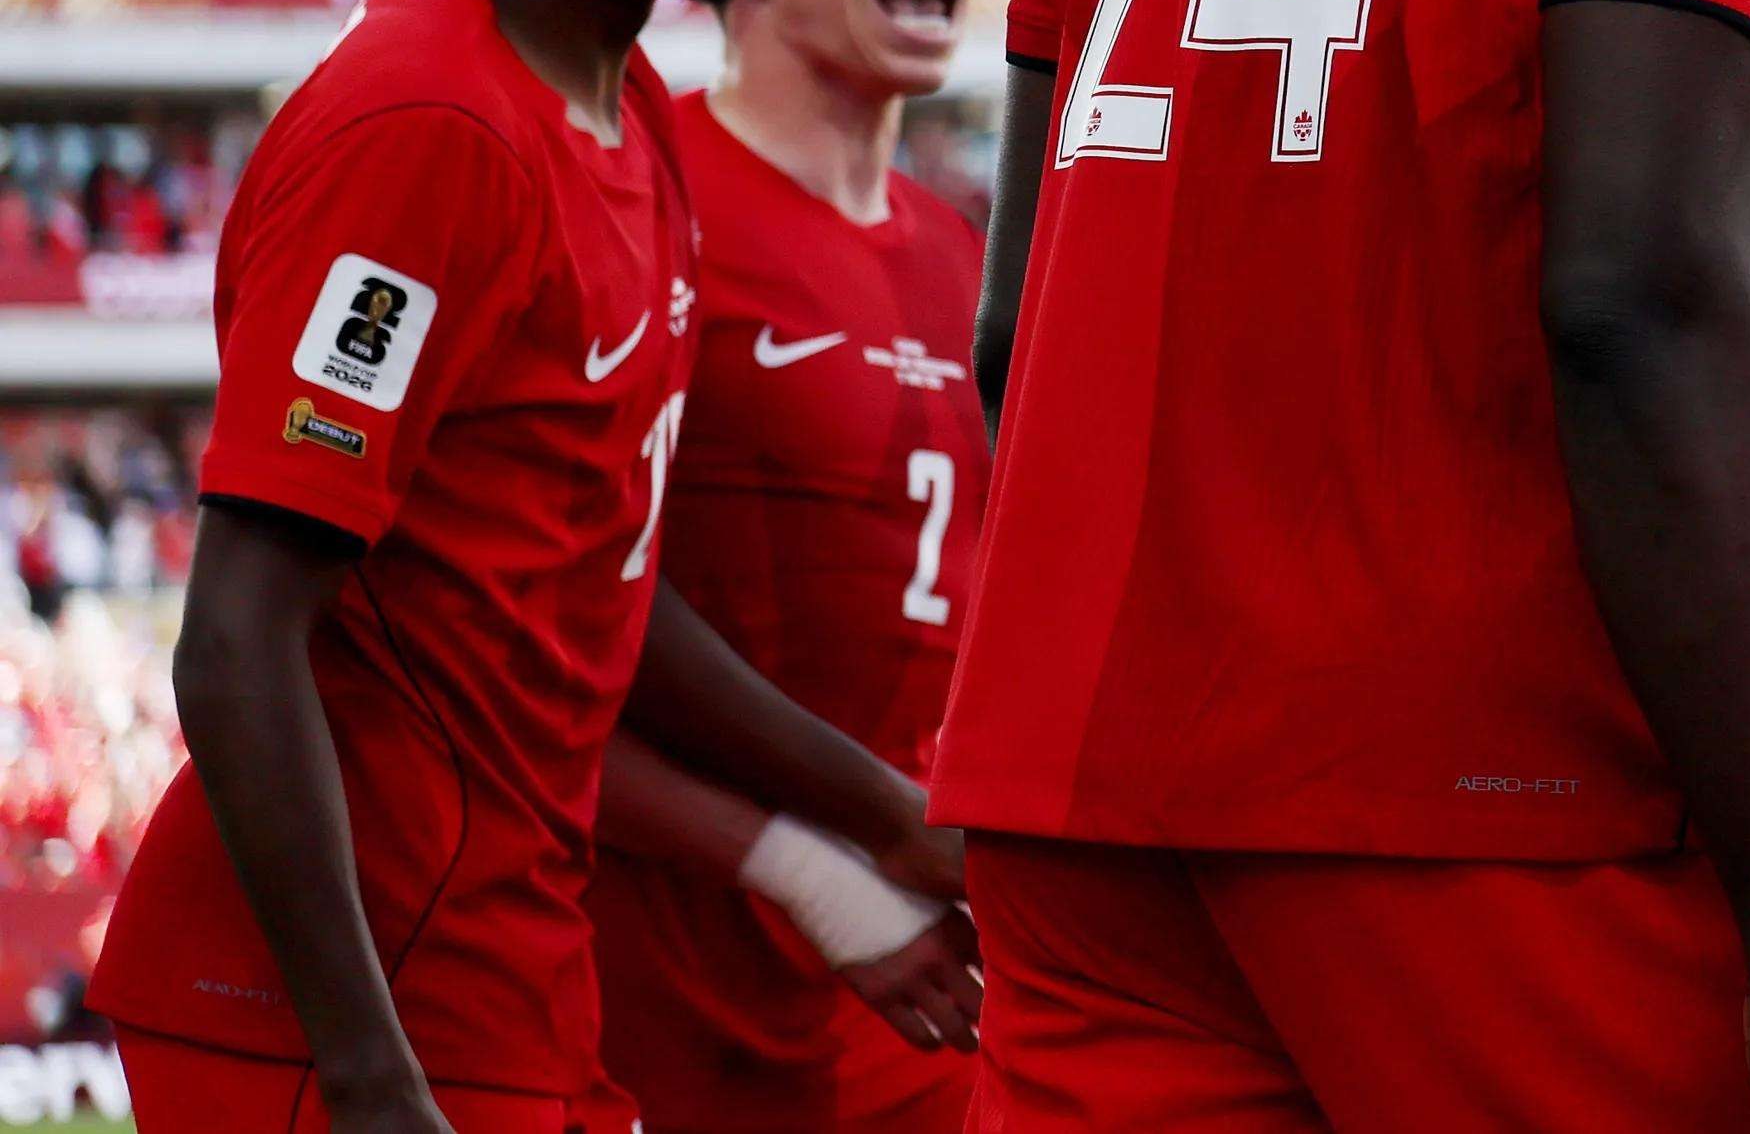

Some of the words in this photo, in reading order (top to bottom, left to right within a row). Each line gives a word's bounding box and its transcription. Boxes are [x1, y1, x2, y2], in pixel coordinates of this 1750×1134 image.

[322, 364, 373, 393] 2026
[903, 448, 955, 626] 2
[1455, 776, 1582, 794] AERO-FIT
